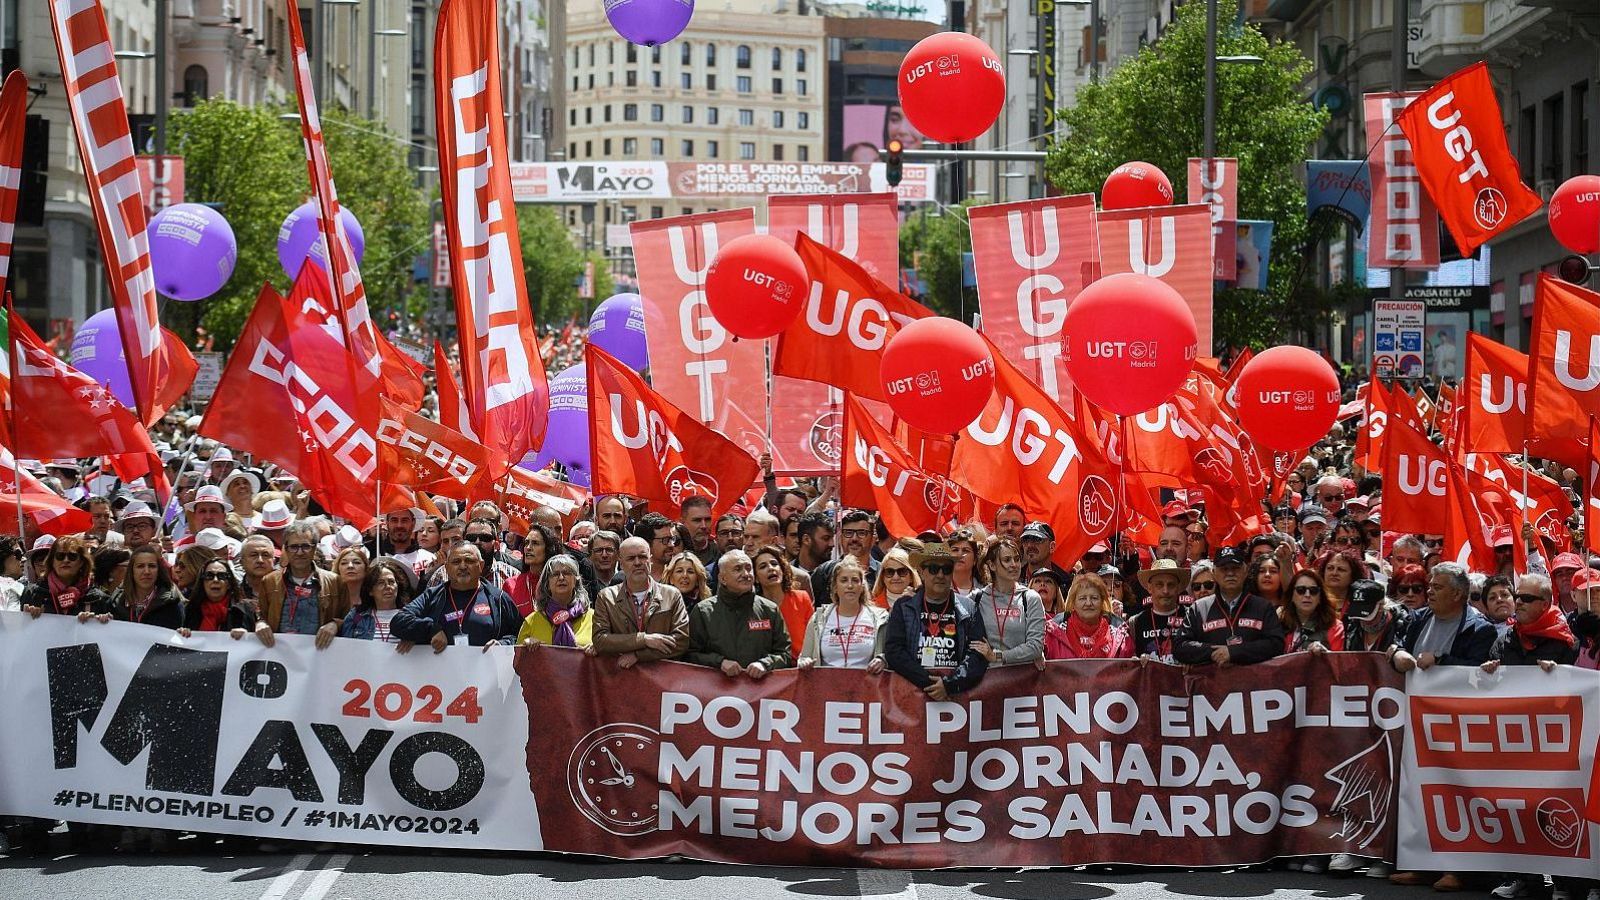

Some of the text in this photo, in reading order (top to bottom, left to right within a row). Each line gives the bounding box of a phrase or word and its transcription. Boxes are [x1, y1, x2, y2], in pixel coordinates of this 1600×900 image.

[906, 61, 934, 84] UGT
[939, 69, 960, 77] Madrid
[1427, 90, 1489, 184] UGT
[696, 164, 727, 174] POR
[730, 164, 747, 174] EL
[750, 164, 791, 174] PLENO
[696, 174, 750, 184] MENOS
[150, 162, 172, 208] UG
[696, 183, 837, 194] MEJORES SALARIOS
[159, 225, 187, 235] CCOO
[744, 268, 775, 288] UGT
[1414, 289, 1438, 297] CASA
[1439, 289, 1451, 297] DE
[806, 280, 916, 351] UG
[1007, 206, 1067, 404] UGT
[1377, 303, 1423, 311] PRECAUCIÓN
[667, 222, 728, 422] UGT
[1087, 341, 1126, 358] UGT
[962, 360, 986, 380] UGT
[887, 377, 913, 396] UGT
[921, 386, 942, 397] Madrid
[1259, 391, 1288, 403] UGT
[967, 395, 1083, 486] UGT
[375, 418, 477, 485] CCOO
[1399, 454, 1446, 496] UG
[1143, 629, 1160, 638] UGT
[1203, 620, 1218, 631] UGT
[1239, 619, 1254, 627] UGT
[342, 679, 483, 723] 2024
[660, 685, 1405, 745] POR EL PLENO EMPLEO
[1422, 714, 1571, 752] CCOO
[658, 742, 1261, 795] MENOS JORNADA,
[54, 789, 480, 834] #PLENOEMPLEO / #1MAYO2024
[658, 784, 1318, 845] MEJORES SALARIOS
[1432, 794, 1526, 844] UGT
